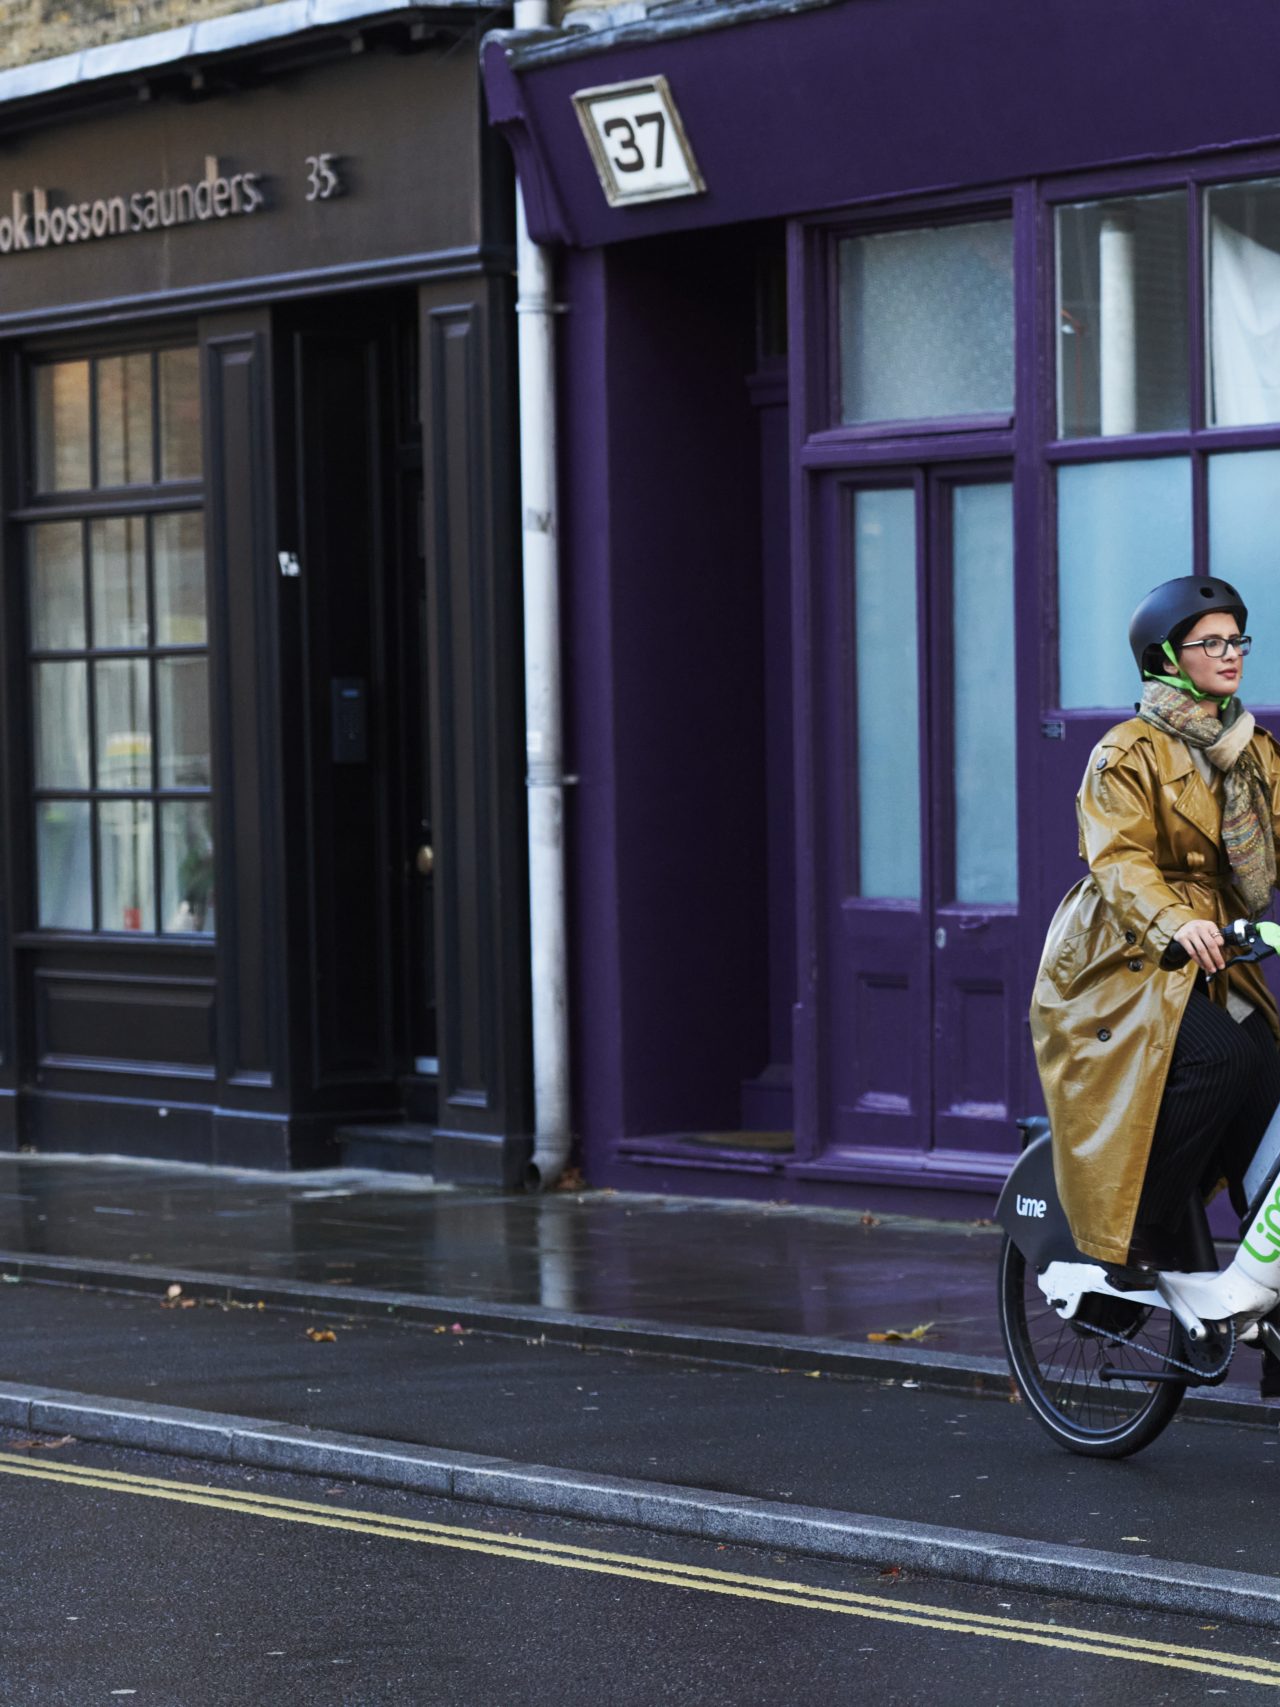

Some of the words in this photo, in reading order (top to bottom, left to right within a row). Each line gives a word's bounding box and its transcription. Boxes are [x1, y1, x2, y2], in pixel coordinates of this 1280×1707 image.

[603, 111, 665, 173] 37
[305, 153, 337, 201] 35
[1016, 1194, 1047, 1218] Lime
